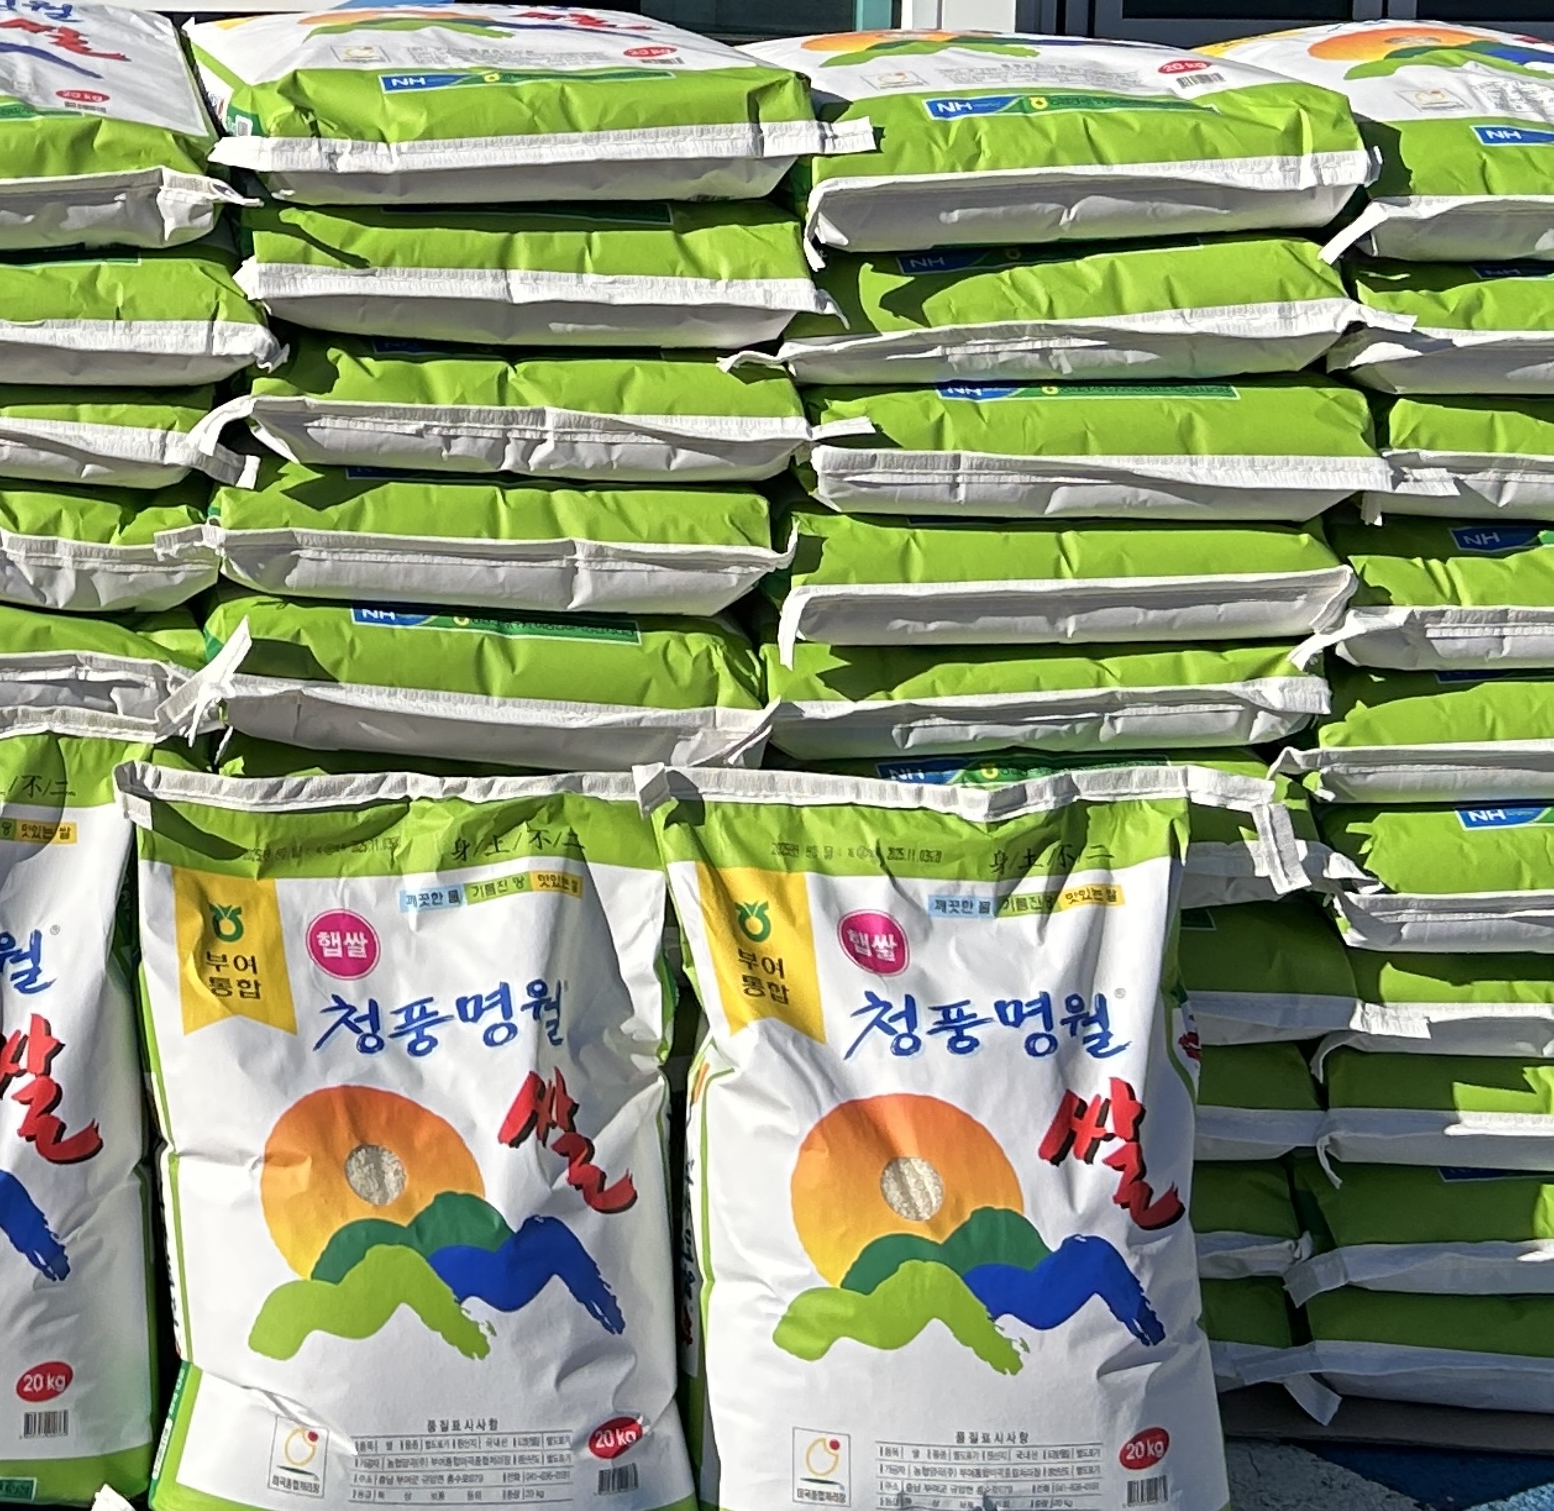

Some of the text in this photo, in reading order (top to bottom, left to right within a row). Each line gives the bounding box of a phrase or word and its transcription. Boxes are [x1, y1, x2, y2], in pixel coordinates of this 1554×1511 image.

[391, 77, 426, 87] NH
[937, 101, 973, 112] NH
[1486, 129, 1522, 139] NH
[909, 256, 945, 267] NH
[947, 386, 982, 396] NH
[1463, 532, 1500, 545] NH
[362, 608, 396, 620] NH
[1469, 810, 1506, 821] NH
[470, 881, 509, 898] 기름진
[934, 899, 974, 914] 깨끗한
[317, 930, 368, 959] 햅쌀
[847, 927, 898, 962] 햅쌀
[205, 951, 258, 977] 부여
[738, 948, 785, 979] 부여
[208, 976, 262, 1001] 통합
[741, 974, 790, 1006] 통합
[313, 978, 565, 1058] 청풍명월
[844, 990, 1132, 1061] 청풍명월
[1038, 1076, 1185, 1230] 쌀
[23, 1374, 66, 1392] 20 kg
[595, 1427, 637, 1448] 20 kg
[1126, 1440, 1163, 1461] 20 kg
